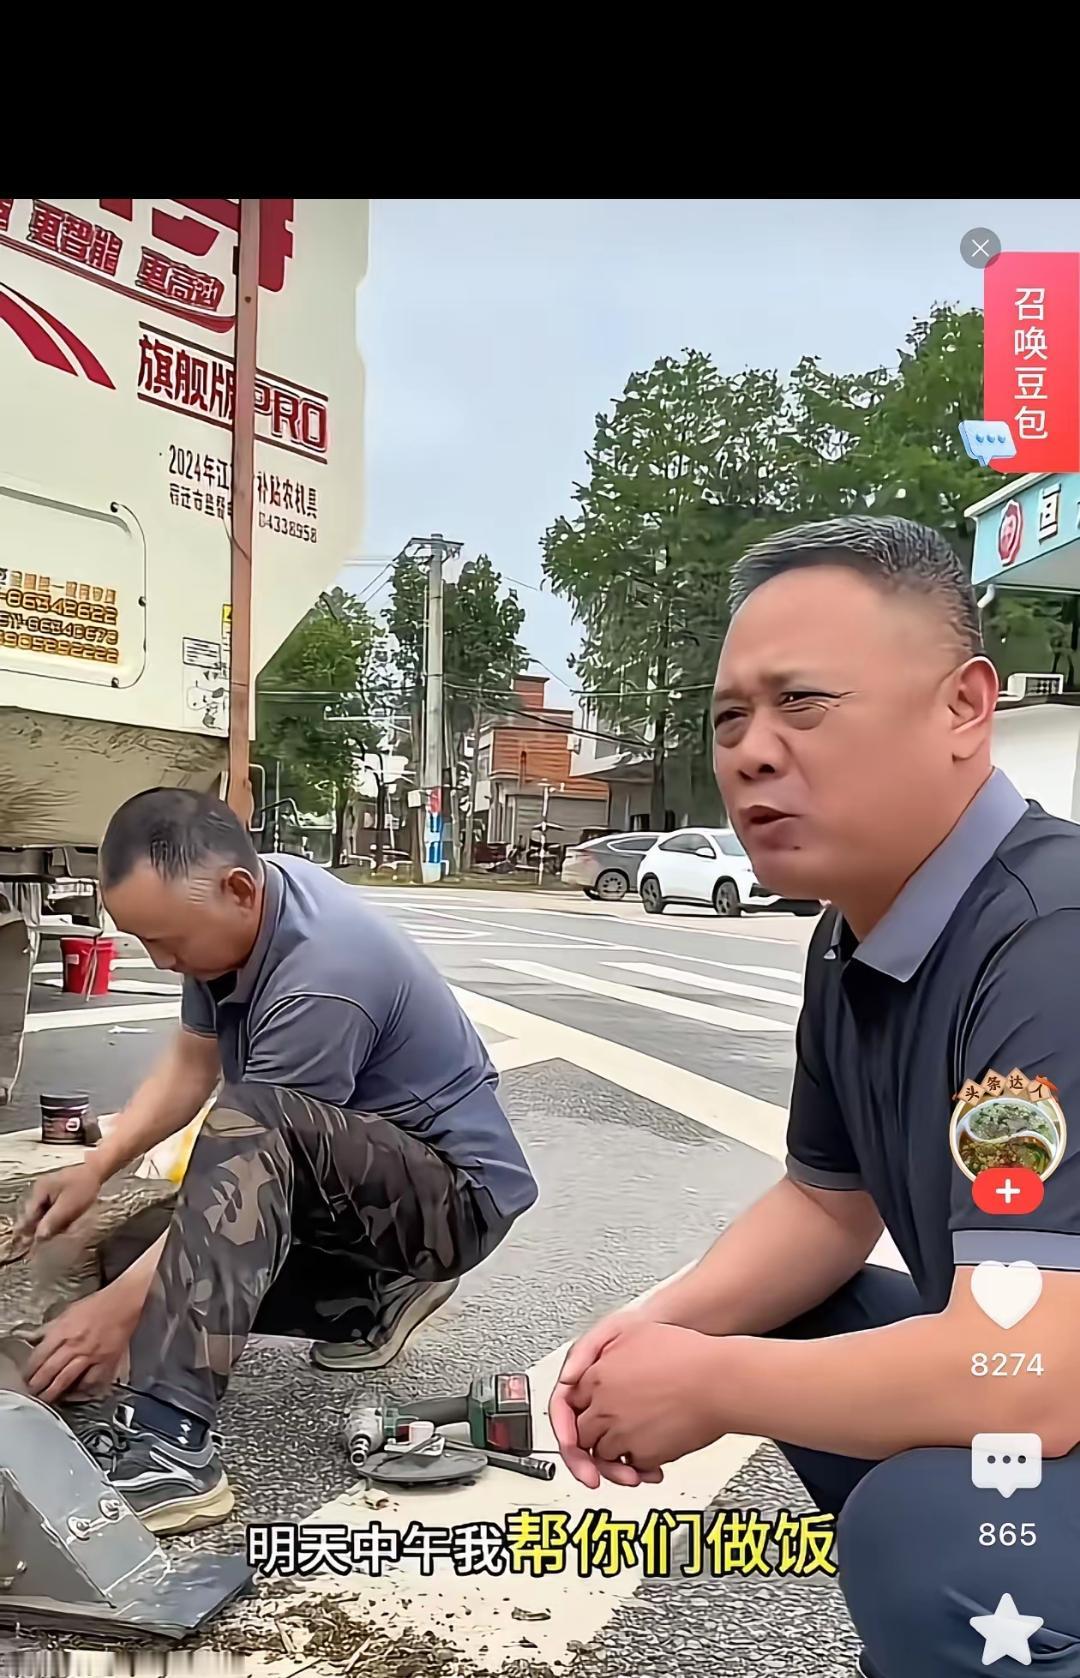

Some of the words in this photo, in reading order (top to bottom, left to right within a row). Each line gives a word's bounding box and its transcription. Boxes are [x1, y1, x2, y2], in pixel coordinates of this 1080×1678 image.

[168, 444, 318, 519] 2024年江补贴农机具
